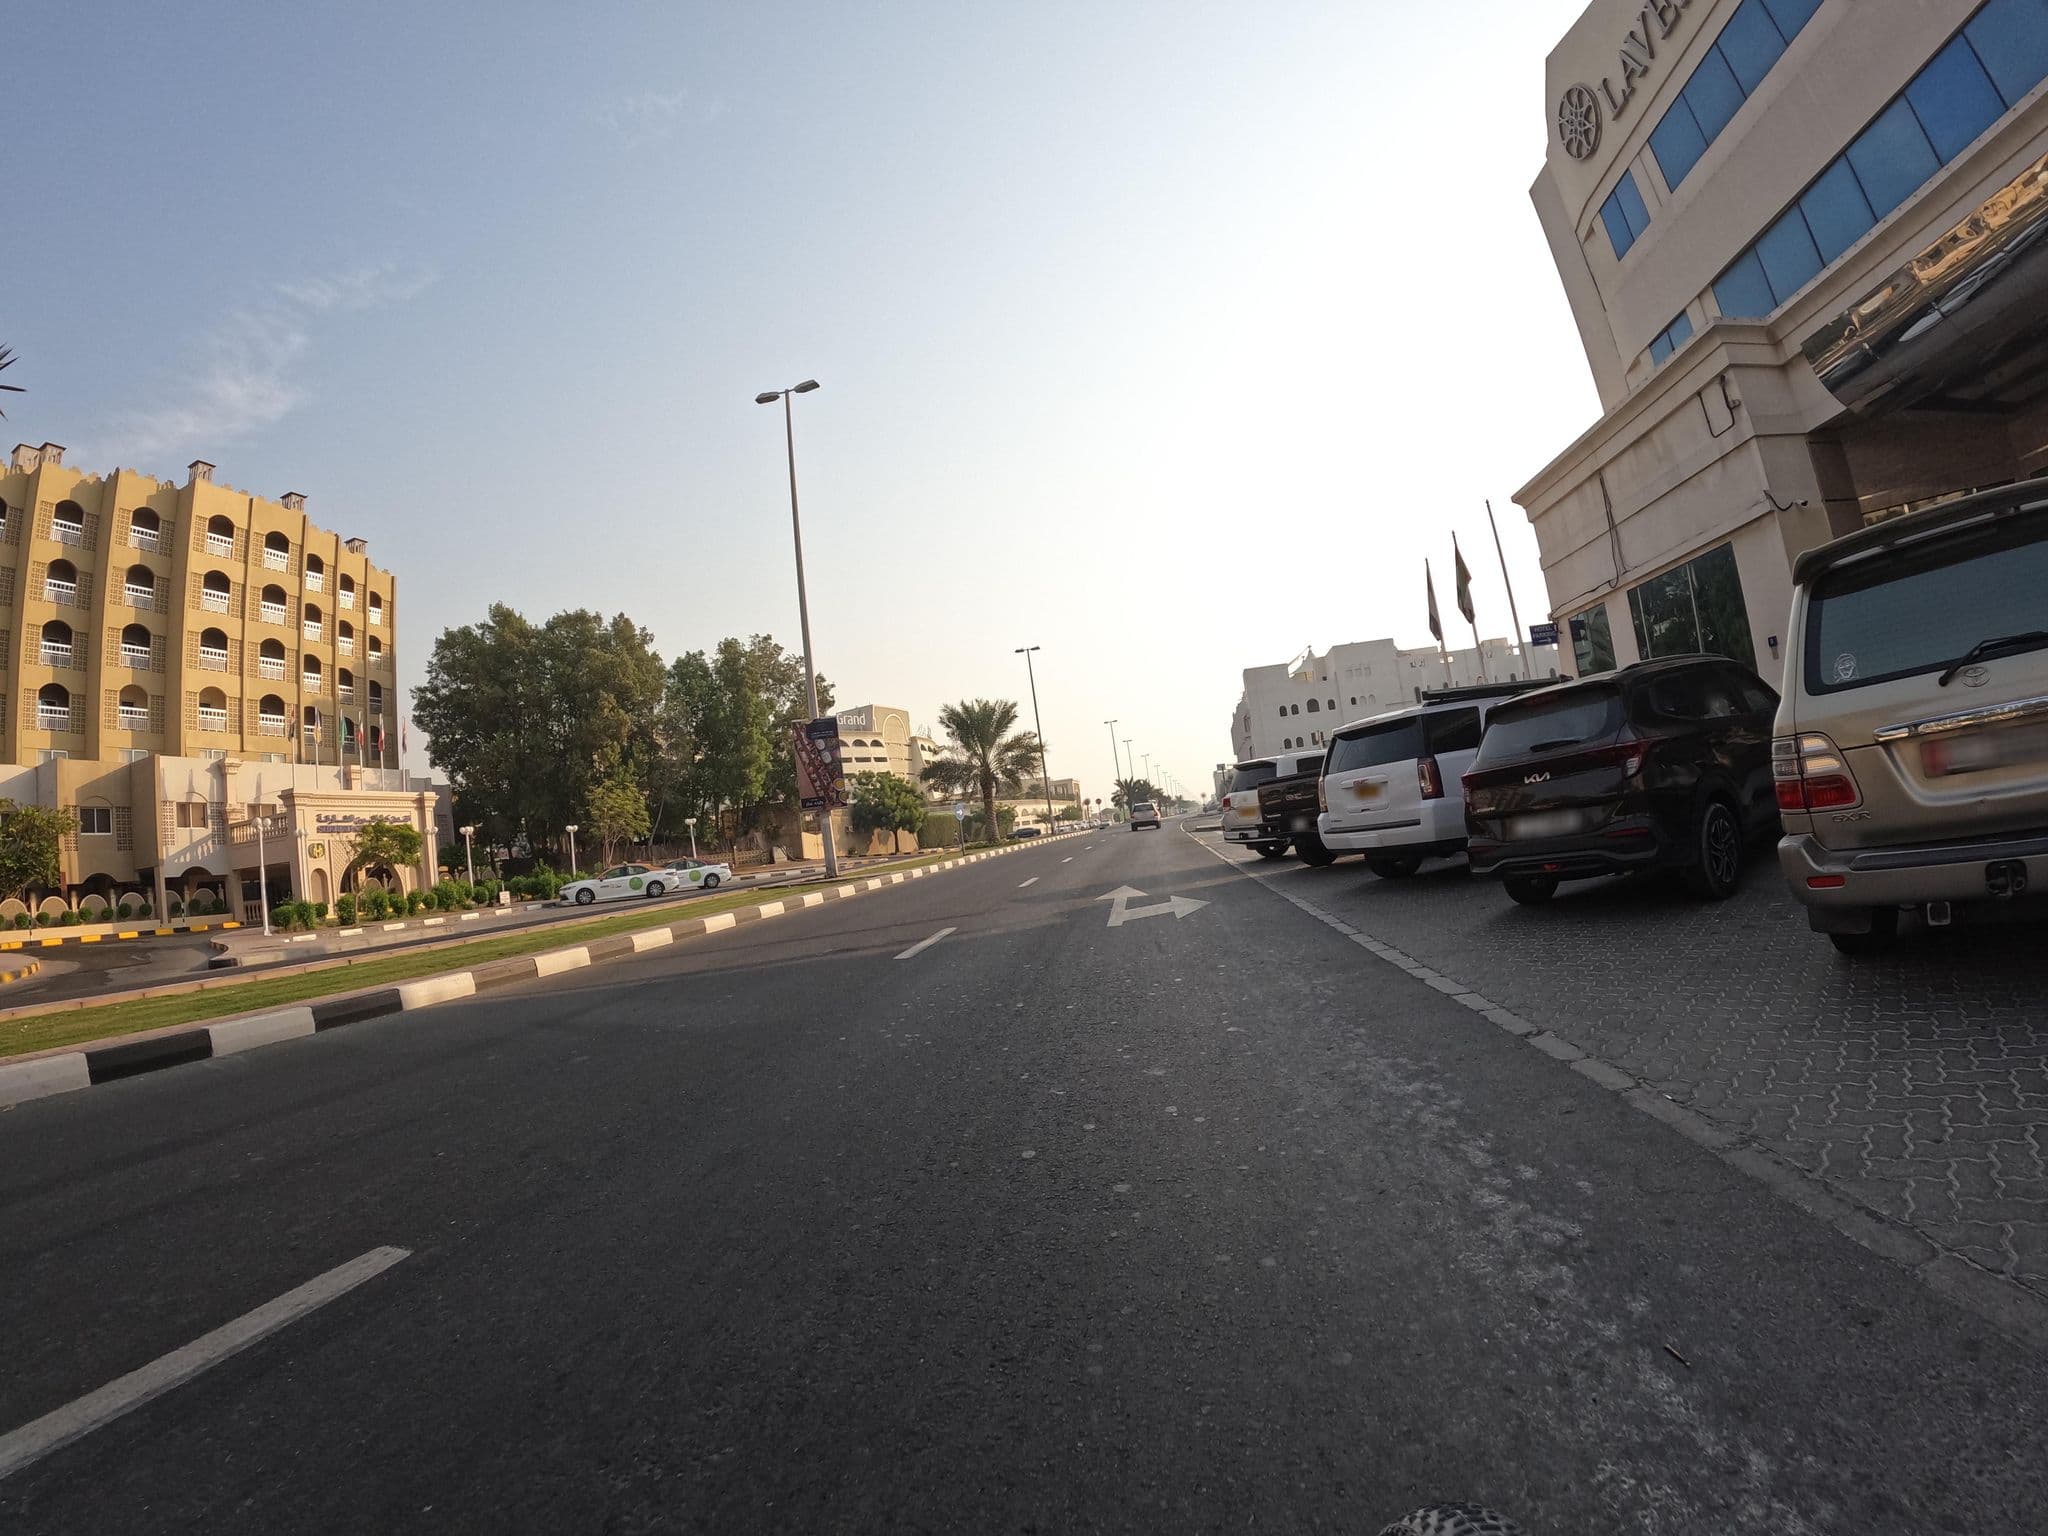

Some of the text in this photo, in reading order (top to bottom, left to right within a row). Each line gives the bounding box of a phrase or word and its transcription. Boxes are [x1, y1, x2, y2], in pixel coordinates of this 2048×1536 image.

[1598, 0, 1691, 121] LAVE
[836, 712, 866, 725] Grand
[1524, 772, 1550, 784] KIA
[1831, 810, 1872, 823] GXR
